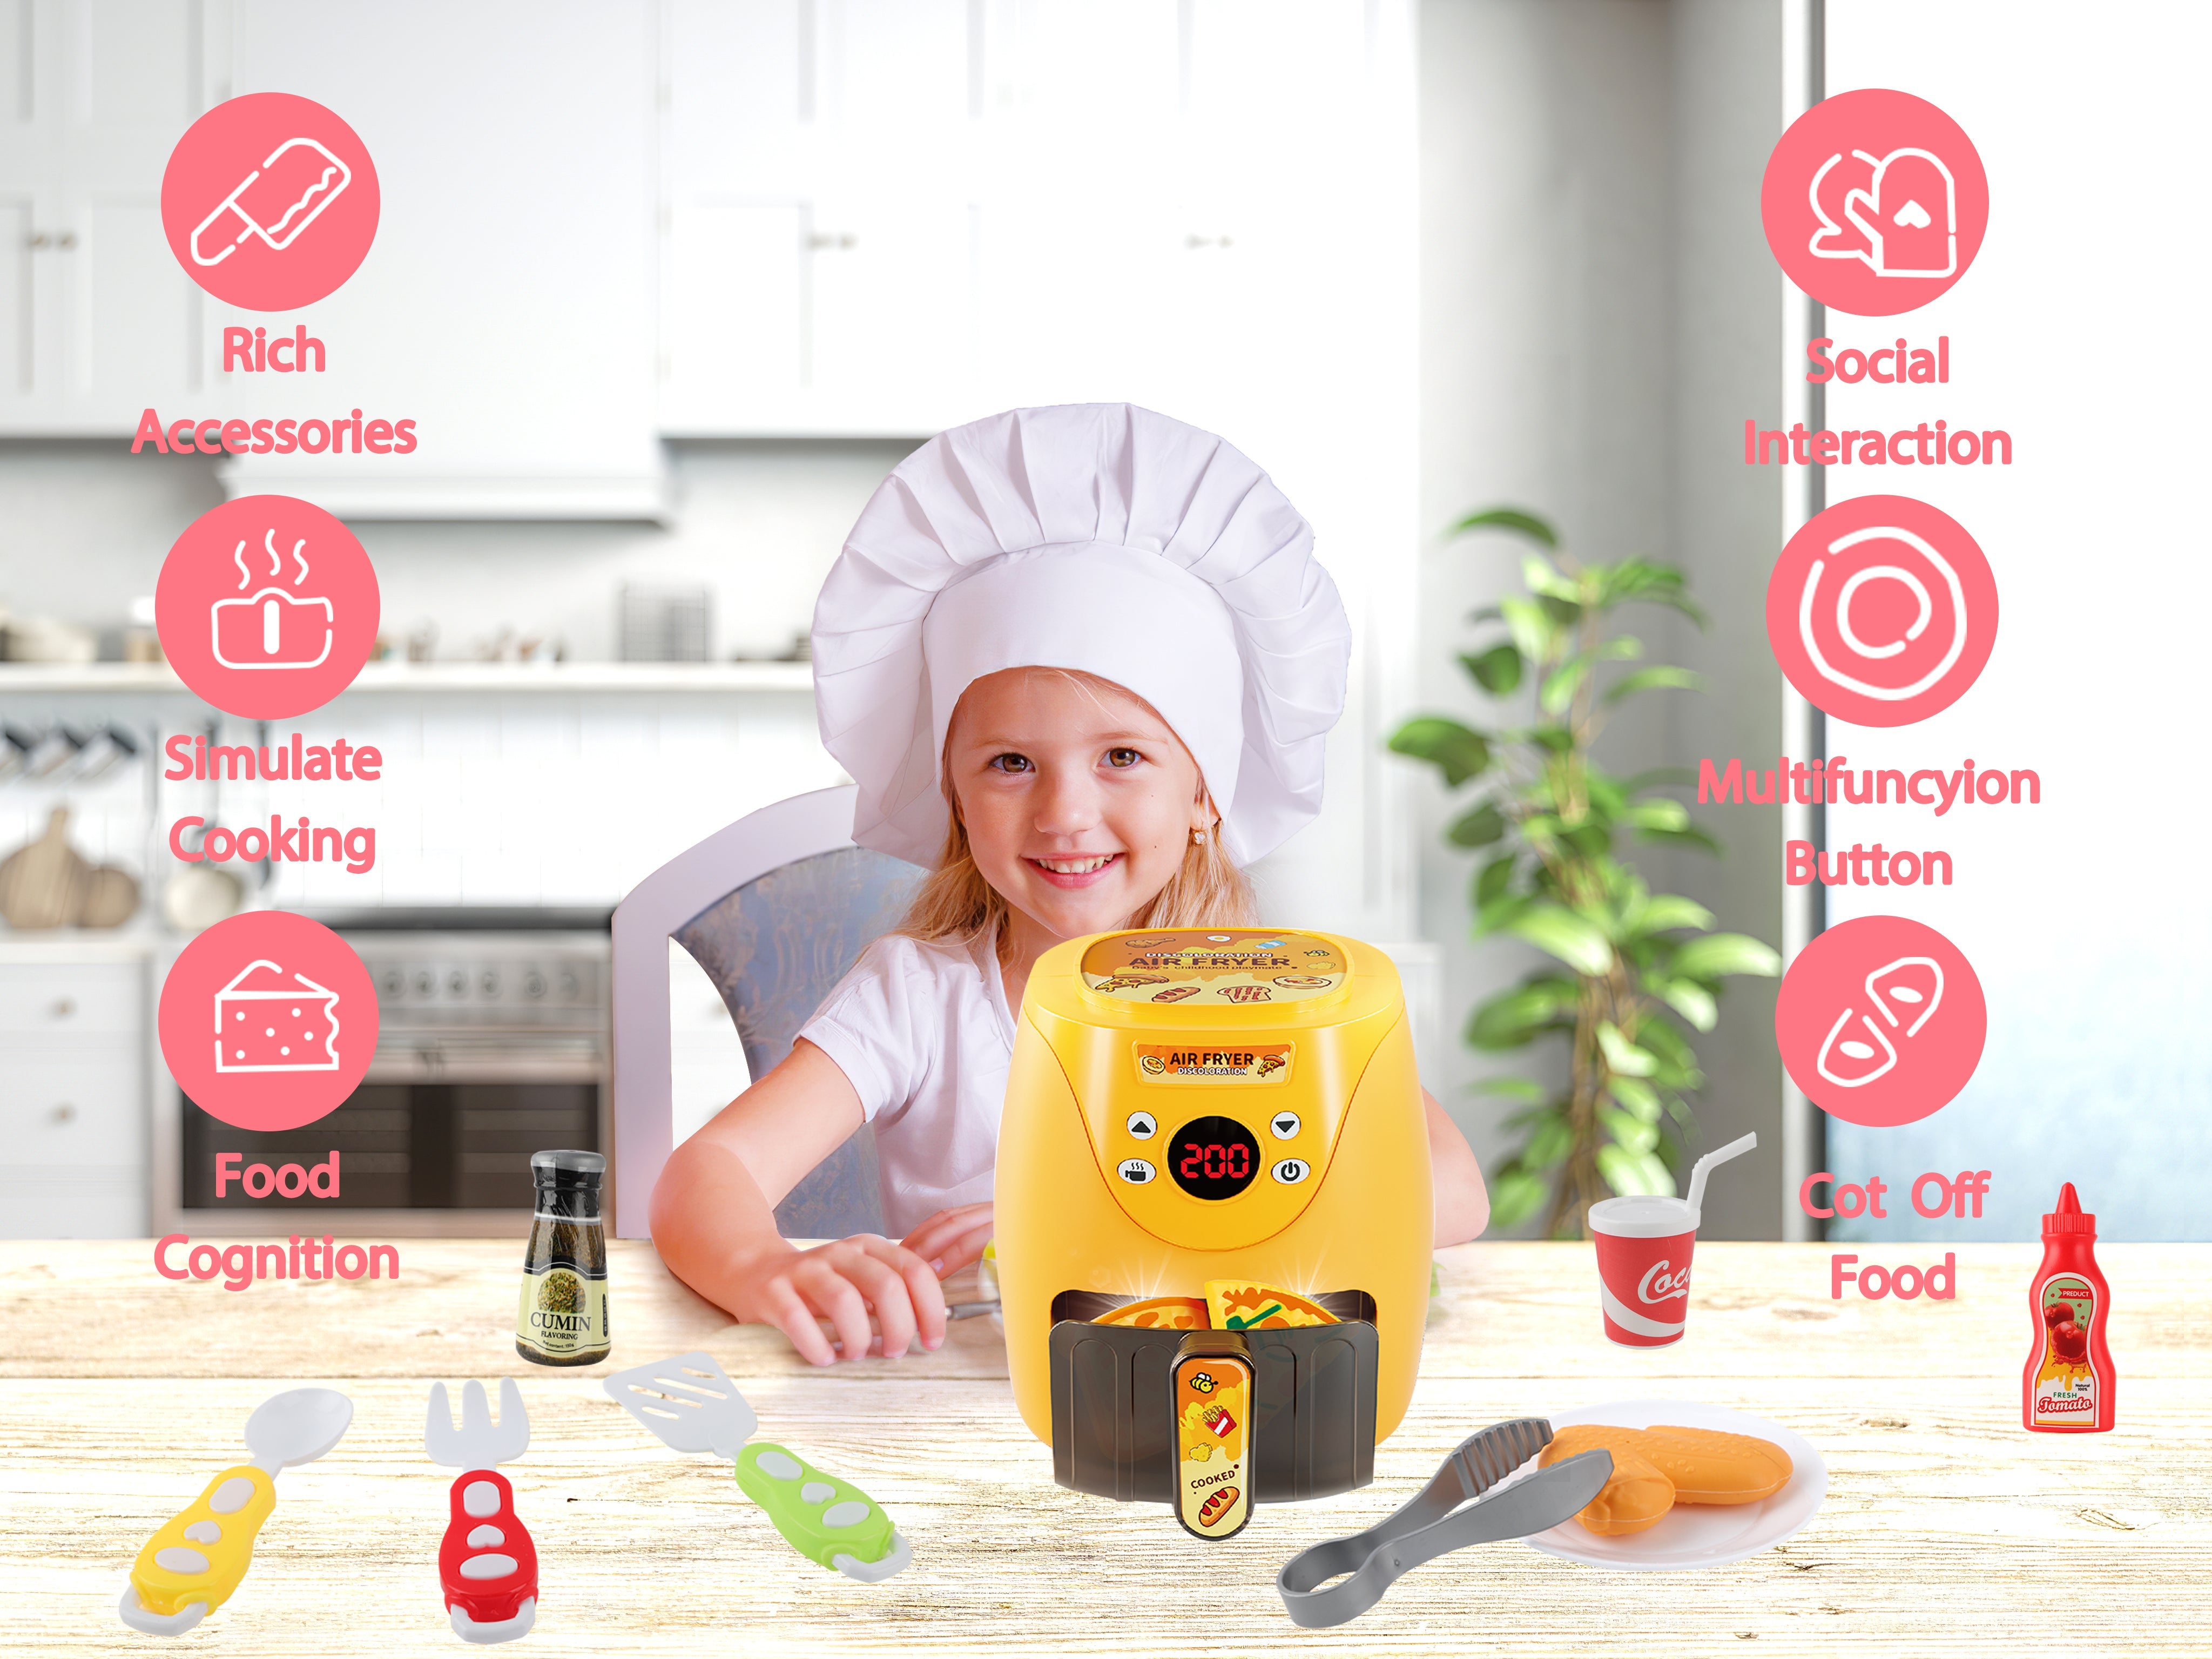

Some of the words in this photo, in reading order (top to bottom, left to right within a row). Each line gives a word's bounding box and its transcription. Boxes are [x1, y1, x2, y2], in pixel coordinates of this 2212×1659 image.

[1129, 957, 1182, 966] AIR
[1192, 957, 1290, 966] FRYER
[1170, 1053, 1198, 1065] AIR
[1203, 1053, 1254, 1065] FRYER
[1177, 1067, 1247, 1075] DISCOLORATION
[1180, 1143, 1249, 1179] 200
[530, 1311, 592, 1332] CUMIN
[541, 1331, 578, 1340] FLAVORING
[2038, 1397, 2092, 1412] Tomato
[1190, 1469, 1236, 1489] COOKED
